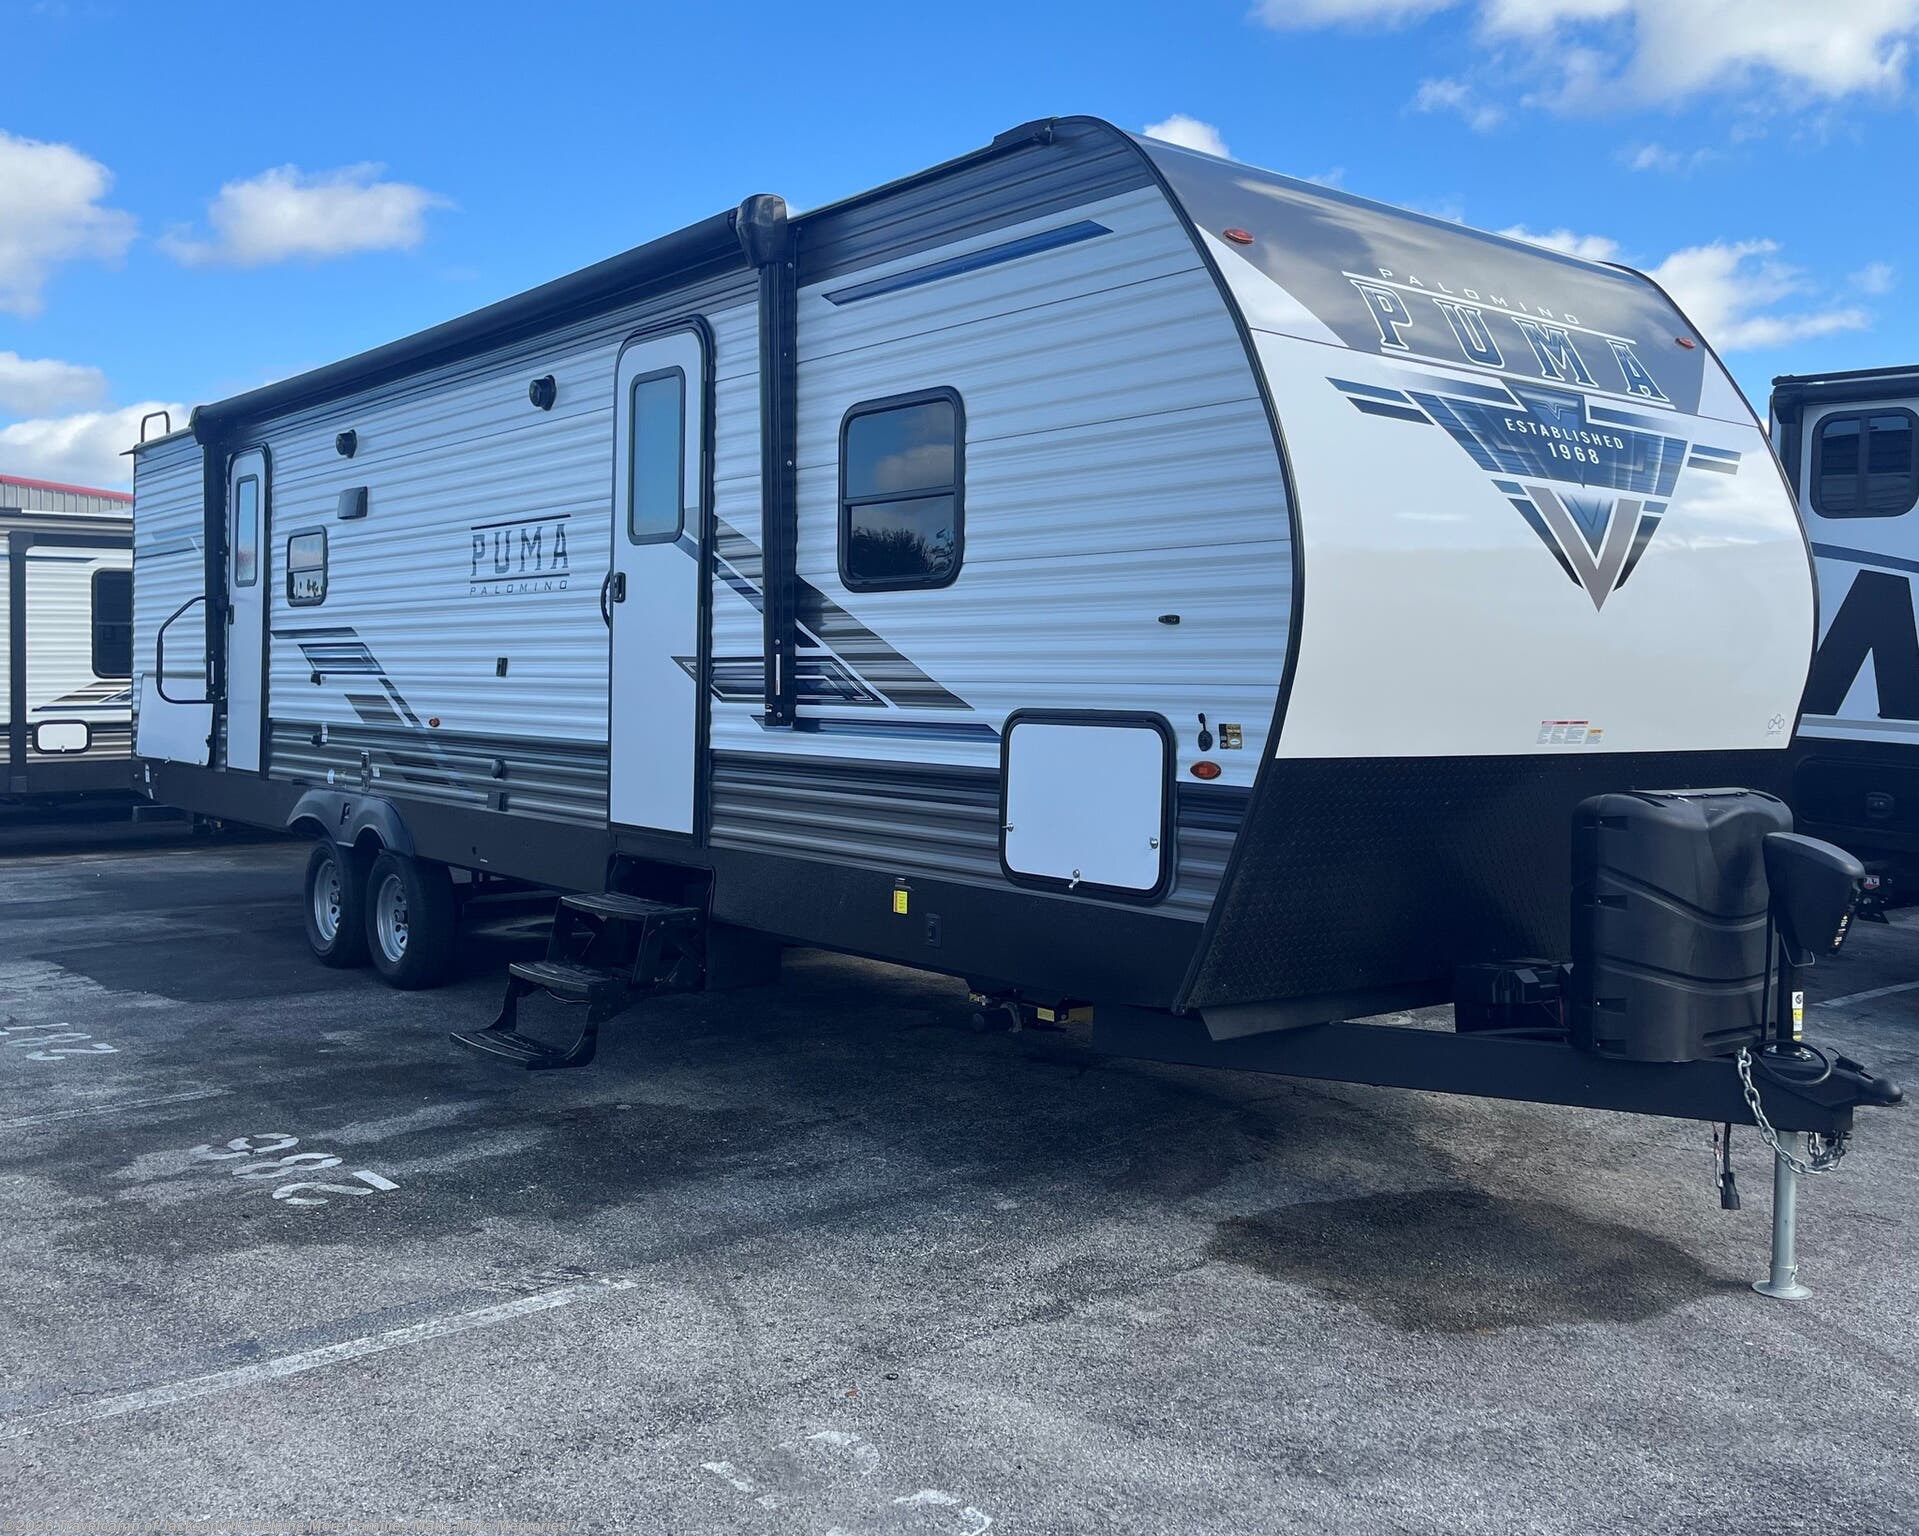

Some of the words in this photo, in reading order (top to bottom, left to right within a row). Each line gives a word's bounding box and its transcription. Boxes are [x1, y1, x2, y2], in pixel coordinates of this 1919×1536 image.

[1379, 267, 1580, 324] PALOMINO
[1350, 279, 1670, 402] PUMA
[1503, 417, 1624, 449] ESTABLISHED
[1547, 441, 1600, 465] 1968
[470, 523, 569, 577] PUMA
[469, 579, 569, 596] PALOMINO
